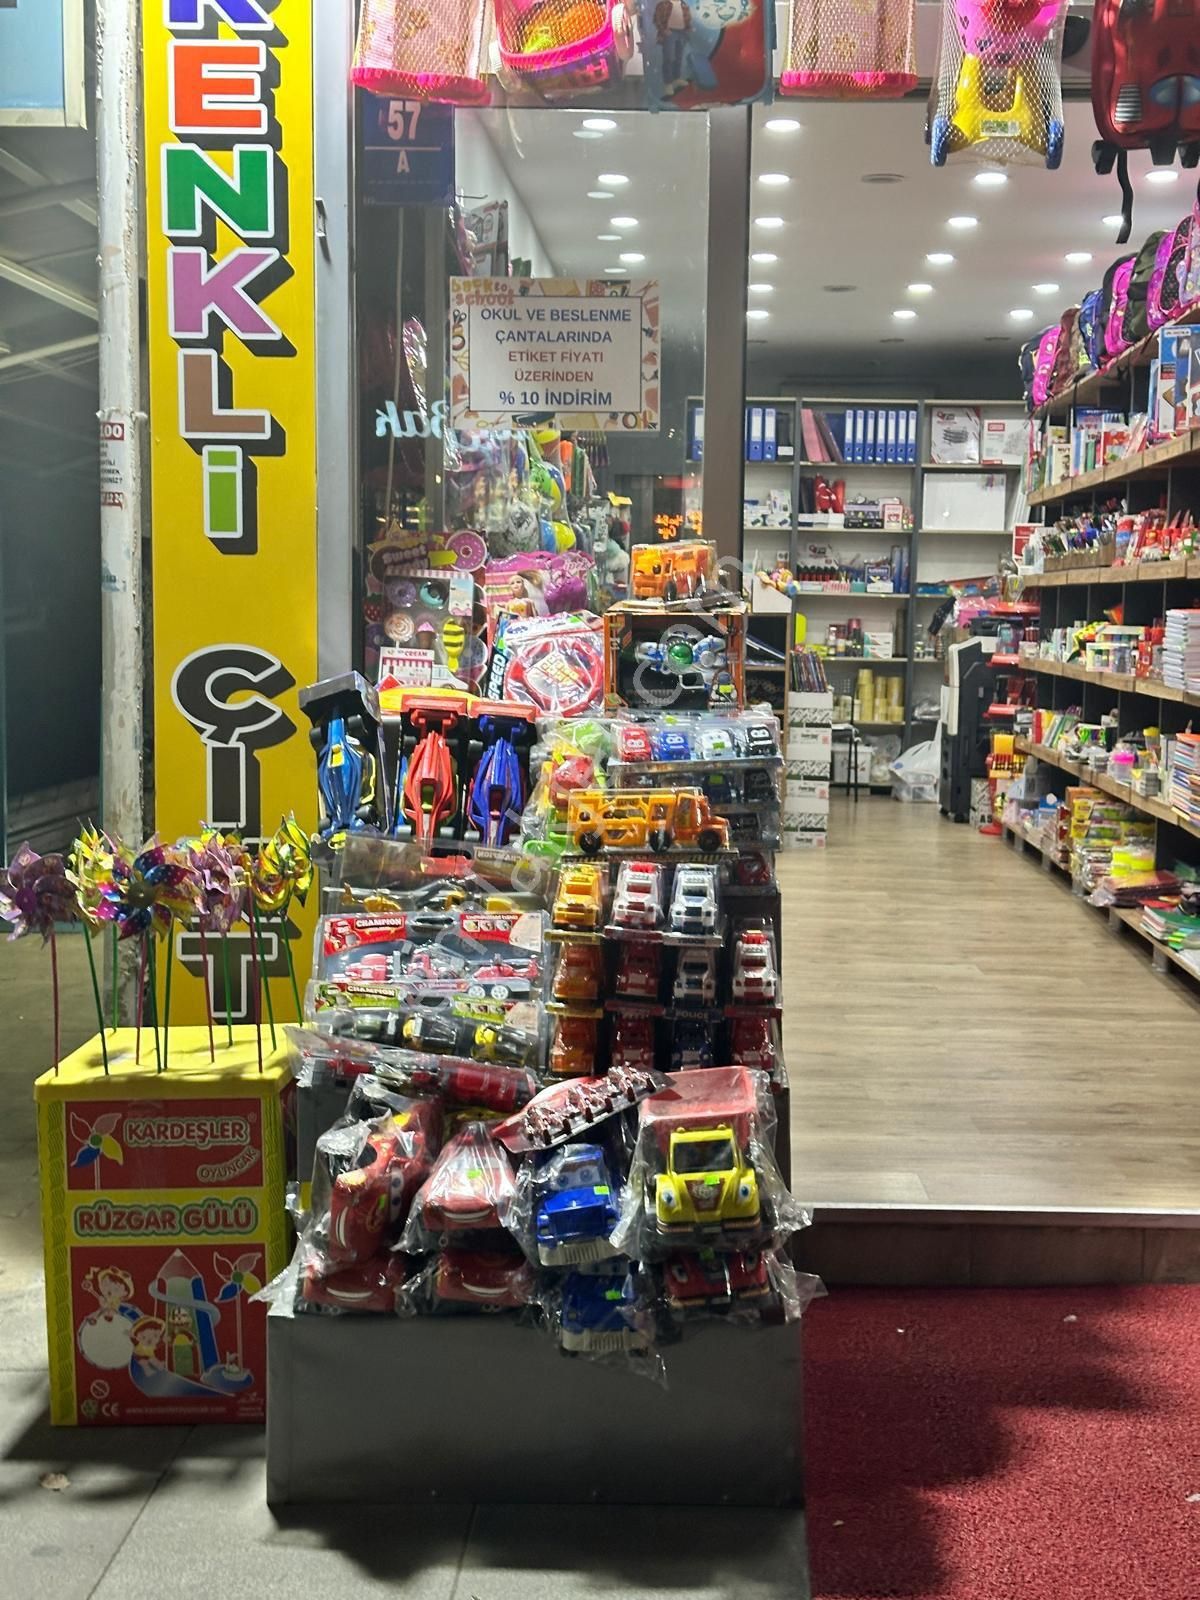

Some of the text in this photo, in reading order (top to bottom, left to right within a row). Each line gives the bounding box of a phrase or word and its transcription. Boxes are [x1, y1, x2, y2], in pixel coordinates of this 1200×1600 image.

[387, 100, 422, 141] 57
[396, 149, 411, 173] A
[162, 0, 284, 540] ENKLİ
[456, 288, 514, 305] school
[481, 307, 631, 322] OKUL VE BESLENME
[495, 330, 613, 345] ÇANTALARINDA
[508, 350, 604, 363] ETİKET FİYATI
[514, 370, 594, 382] ÜZERİNDEN
[499, 388, 612, 406] % 10 İNDİRİM
[487, 652, 507, 701] SPEED
[355, 917, 402, 928] CHAMPION
[347, 985, 395, 997] CHAMPION
[676, 1010, 709, 1019] POLICE
[127, 1120, 245, 1143] KARDEŞLER
[199, 1148, 258, 1180] OYUNCAK
[78, 1201, 252, 1232] RÜZGAR GÜLÜ
